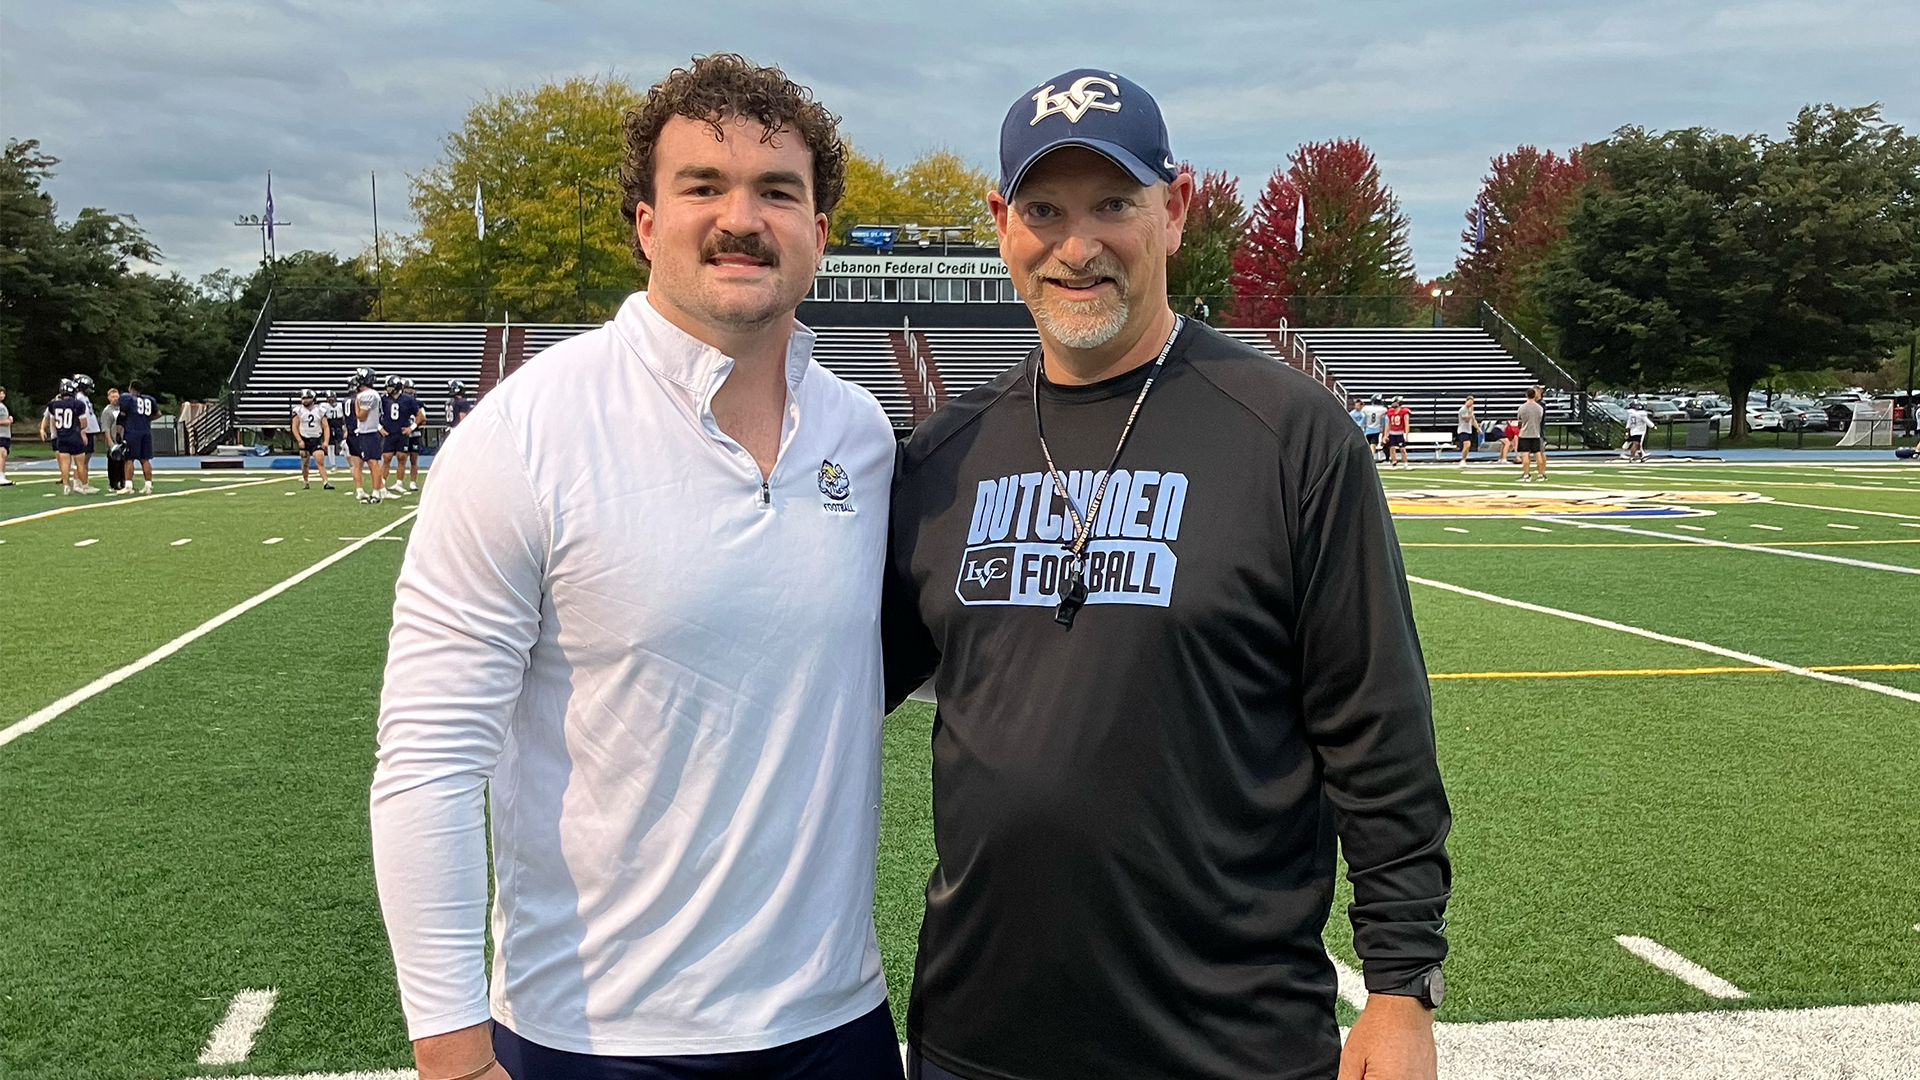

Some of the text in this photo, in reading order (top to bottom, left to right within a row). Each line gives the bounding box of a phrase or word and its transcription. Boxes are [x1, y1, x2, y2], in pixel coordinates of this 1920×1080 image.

[825, 261, 1008, 275] Lebanon Federal Credit Unio
[137, 397, 152, 416] 99
[391, 402, 399, 420] 6
[54, 408, 73, 429] 50
[307, 414, 314, 428] 2
[823, 503, 855, 512] FOOTBALL
[967, 469, 1188, 545] DUTCHMEN
[964, 557, 1008, 588] LVC
